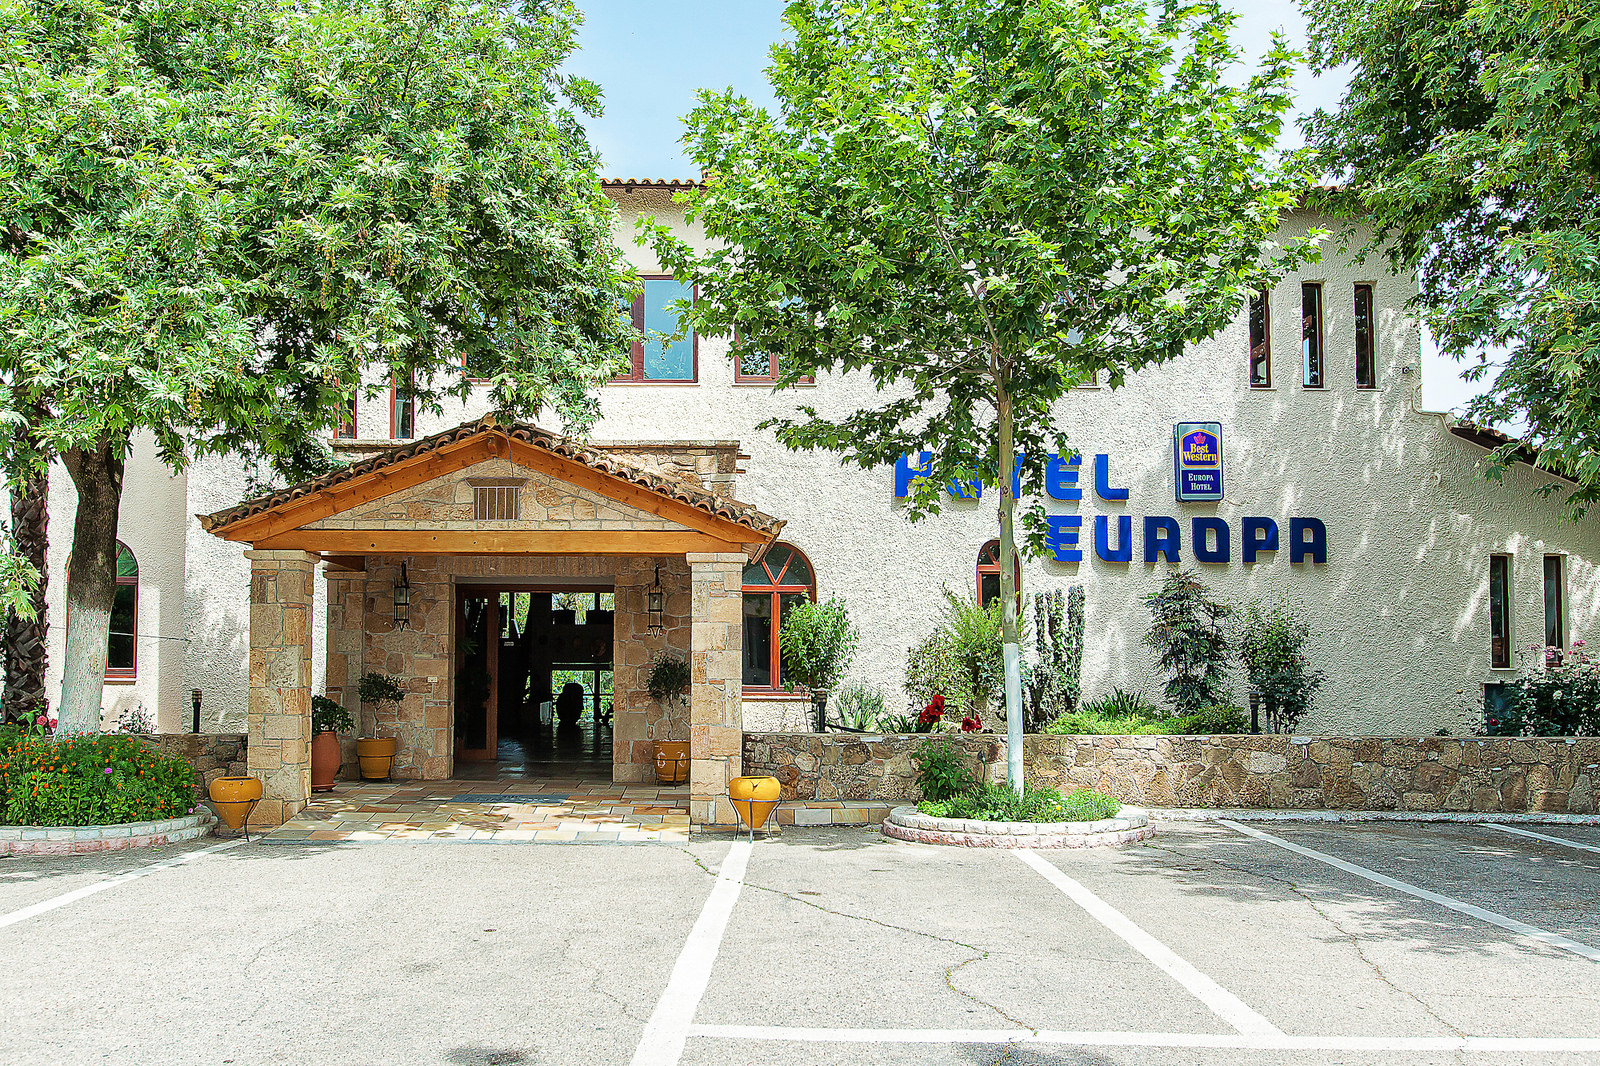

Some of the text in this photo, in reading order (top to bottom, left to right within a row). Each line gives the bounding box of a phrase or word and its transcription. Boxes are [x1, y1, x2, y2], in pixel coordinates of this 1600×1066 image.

[1190, 443, 1209, 454] Best
[1183, 451, 1218, 464] Western
[1046, 515, 1327, 564] EUROPA
